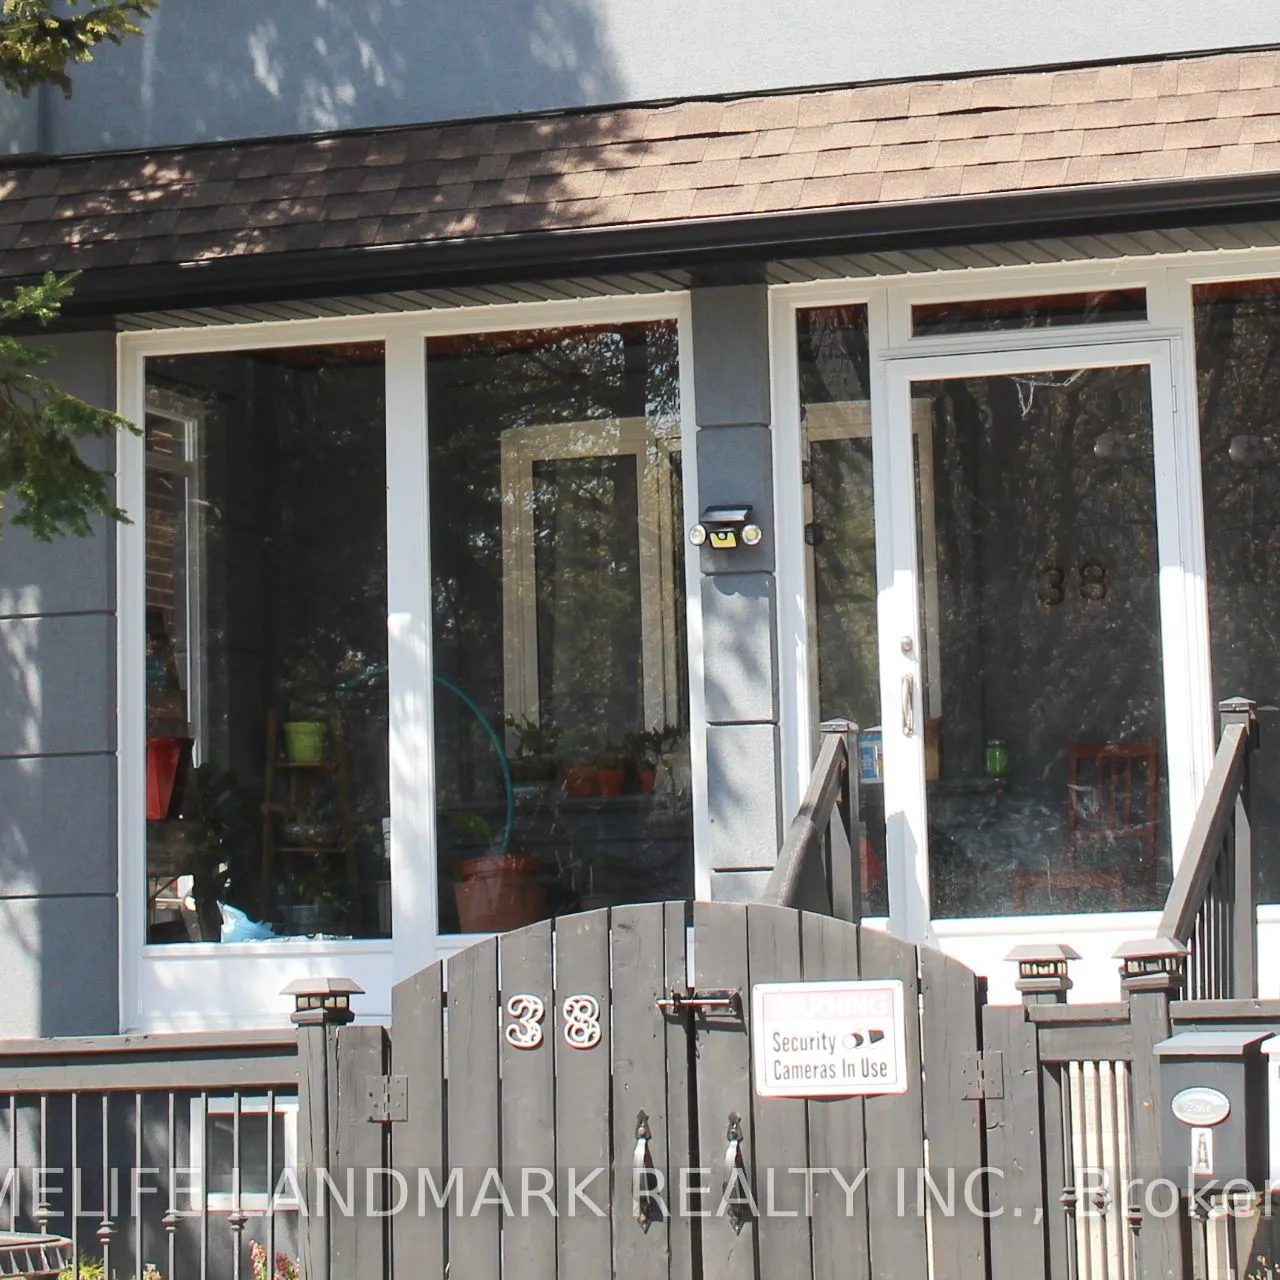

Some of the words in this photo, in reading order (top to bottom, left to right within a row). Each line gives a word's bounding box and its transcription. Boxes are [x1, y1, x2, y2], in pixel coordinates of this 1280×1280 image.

[1037, 563, 1107, 605] 38
[505, 994, 603, 1050] 38
[772, 993, 887, 1019] WARNING
[772, 1030, 837, 1056] Security
[773, 1059, 837, 1081] Cameras
[841, 1058, 856, 1079] In
[861, 1057, 888, 1079] Use
[1196, 1132, 1210, 1170] A
